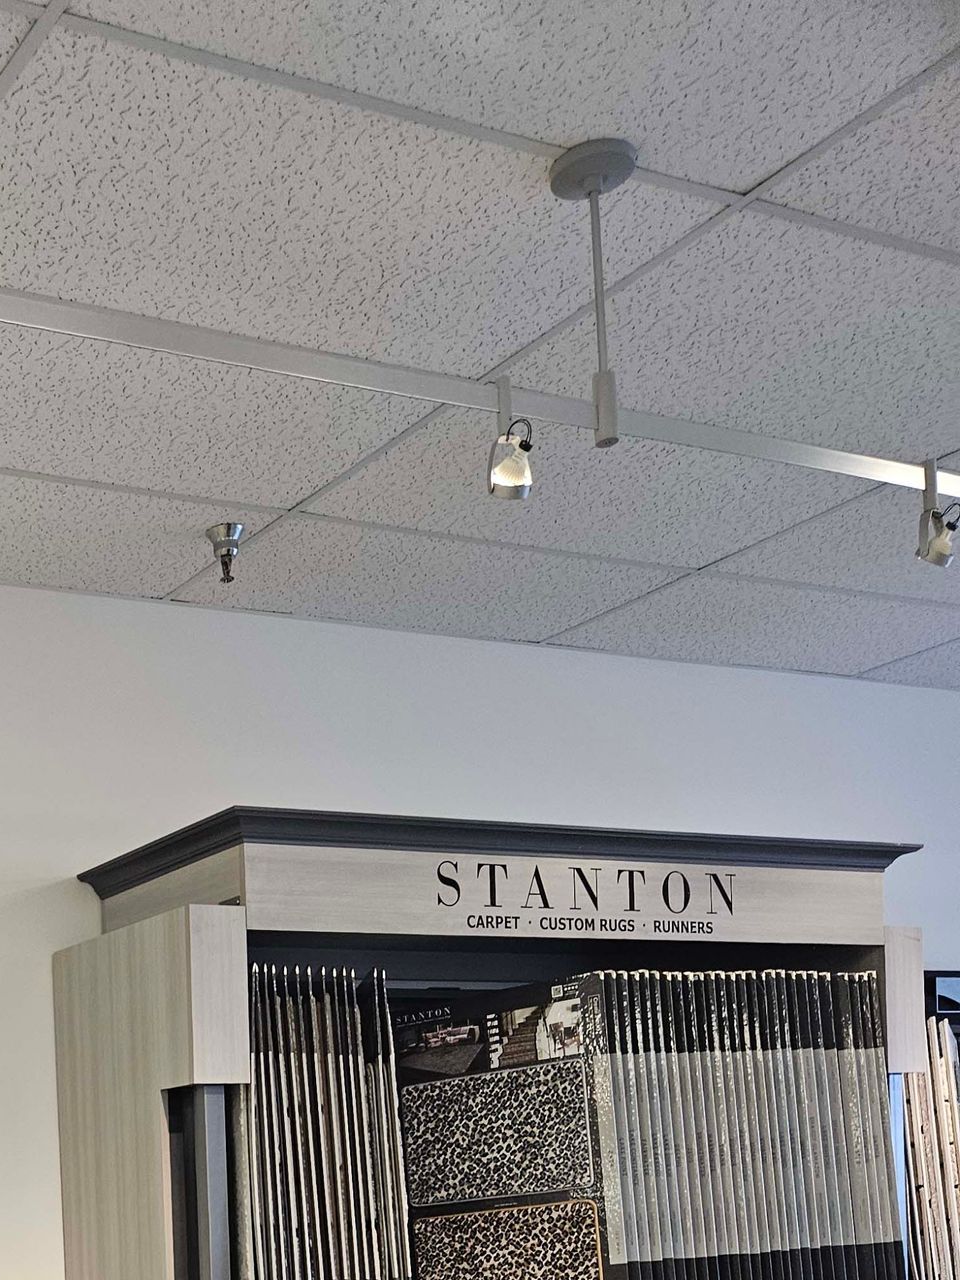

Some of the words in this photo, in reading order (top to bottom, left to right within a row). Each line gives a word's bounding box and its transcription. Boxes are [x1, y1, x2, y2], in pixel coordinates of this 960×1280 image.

[437, 860, 736, 916] STANTON
[467, 915, 520, 930] CARPET
[540, 917, 595, 932] CUSTOM
[599, 919, 635, 933] RUGS
[653, 920, 714, 934] RUNNERS
[396, 1007, 451, 1023] STANTON
